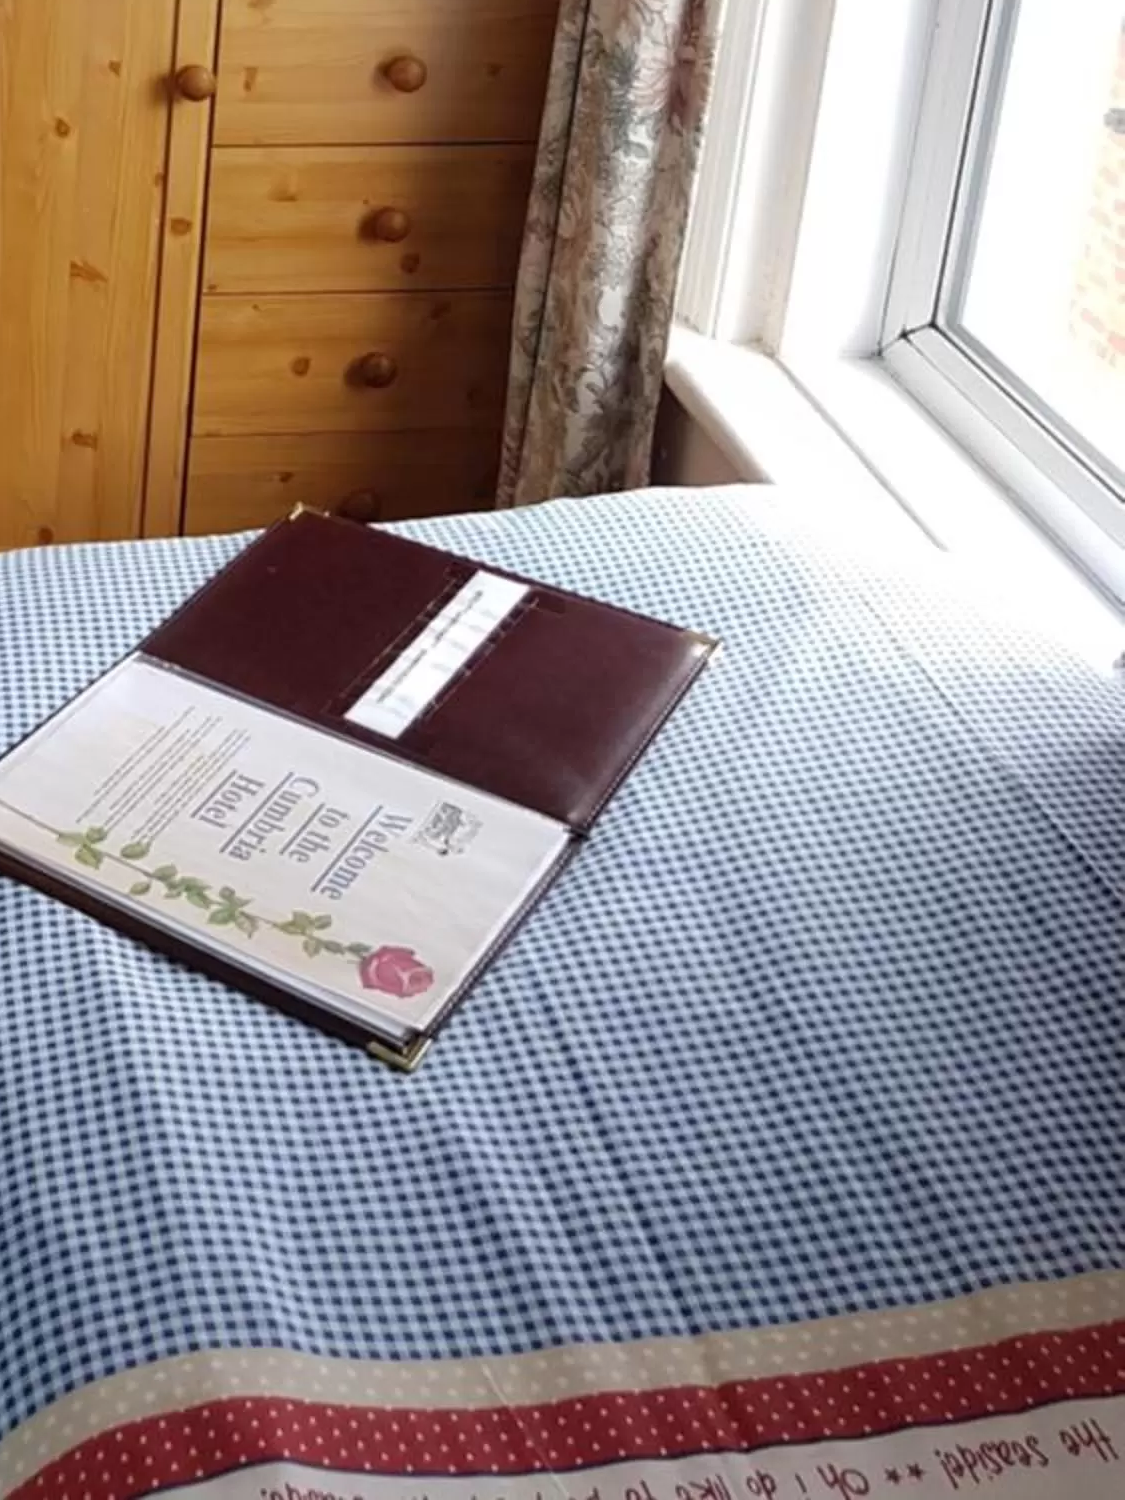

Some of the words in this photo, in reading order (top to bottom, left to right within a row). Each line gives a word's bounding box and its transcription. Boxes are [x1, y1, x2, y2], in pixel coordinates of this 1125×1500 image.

[197, 773, 266, 830] Hotel
[228, 775, 321, 862] Cumbria
[318, 806, 351, 829] to
[289, 829, 332, 863] the
[321, 811, 414, 901] Welcome
[934, 1433, 1050, 1490] seaside!
[1058, 1417, 1119, 1463] the
[817, 1462, 870, 1500] Oh
